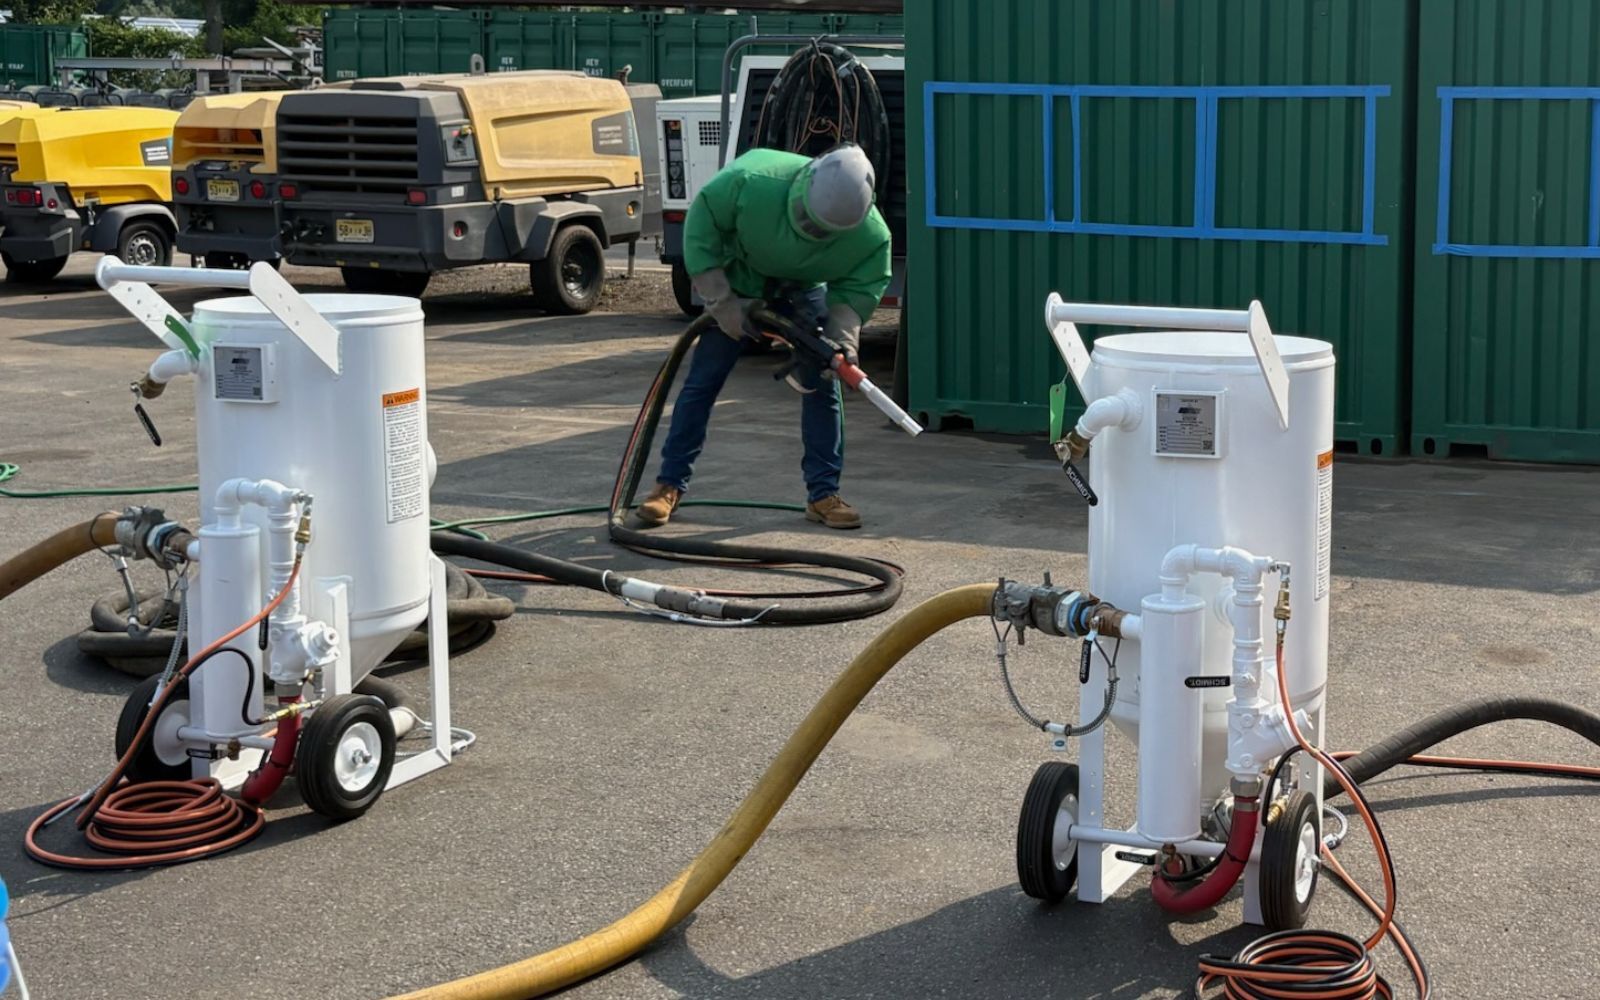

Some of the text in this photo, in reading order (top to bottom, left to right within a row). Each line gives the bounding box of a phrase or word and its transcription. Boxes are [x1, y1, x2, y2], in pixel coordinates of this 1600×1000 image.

[661, 79, 694, 87] OVERFLOW
[1066, 466, 1093, 500] SCHMIDT
[1189, 678, 1226, 687] SCHMIDT
